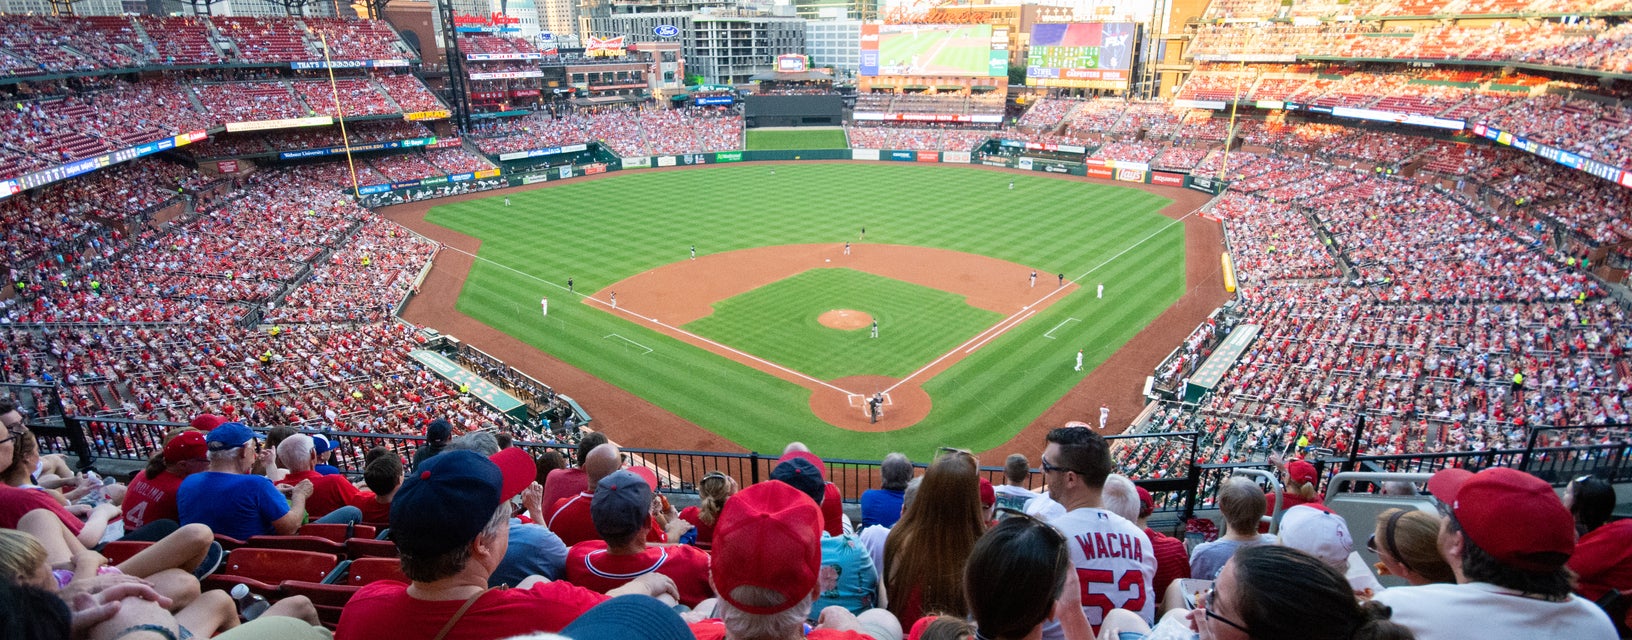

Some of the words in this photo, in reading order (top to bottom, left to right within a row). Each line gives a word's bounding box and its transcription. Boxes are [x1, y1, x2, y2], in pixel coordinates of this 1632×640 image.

[658, 26, 676, 36] Ford
[589, 40, 622, 49] Budweiser
[302, 149, 325, 157] University
[134, 481, 165, 502] MOLINA
[126, 501, 148, 527] 4
[1075, 532, 1143, 563] WACHA
[1075, 567, 1147, 639] 52
